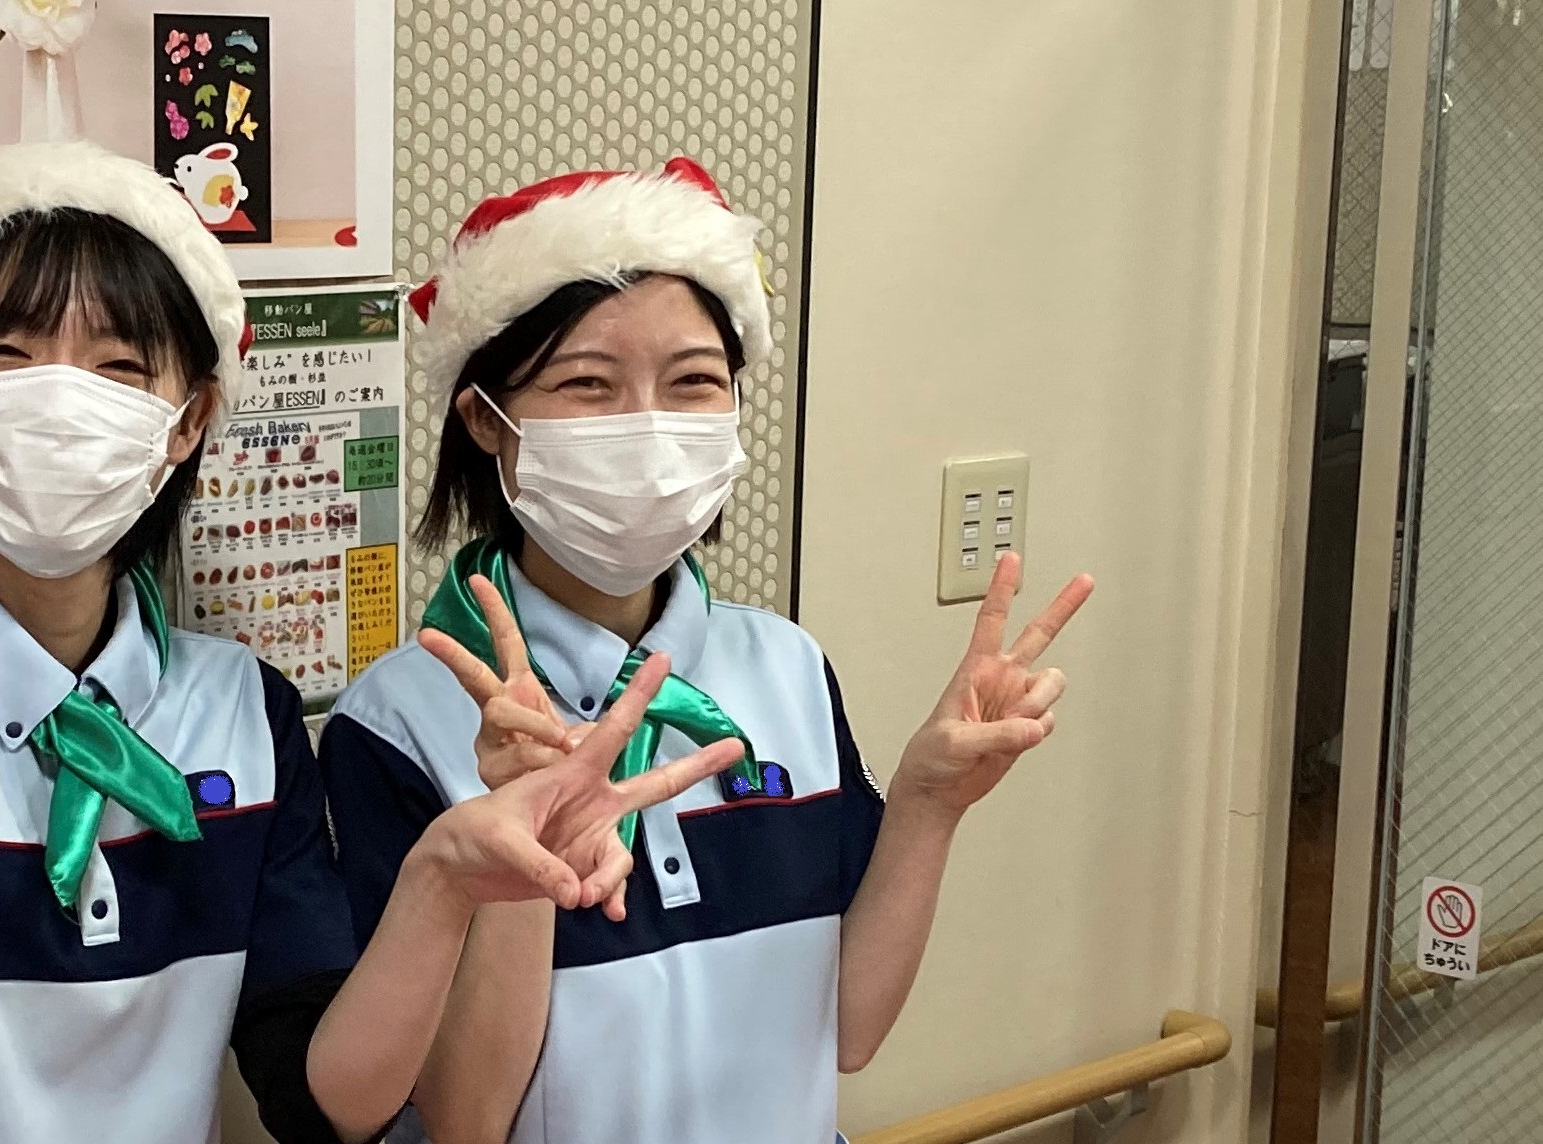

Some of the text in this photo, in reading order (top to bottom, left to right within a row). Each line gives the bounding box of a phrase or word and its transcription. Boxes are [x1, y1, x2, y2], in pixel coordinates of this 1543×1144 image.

[334, 386, 385, 403] のご案内
[1432, 938, 1467, 956] ドアに
[1423, 953, 1471, 971] ちゅうい
